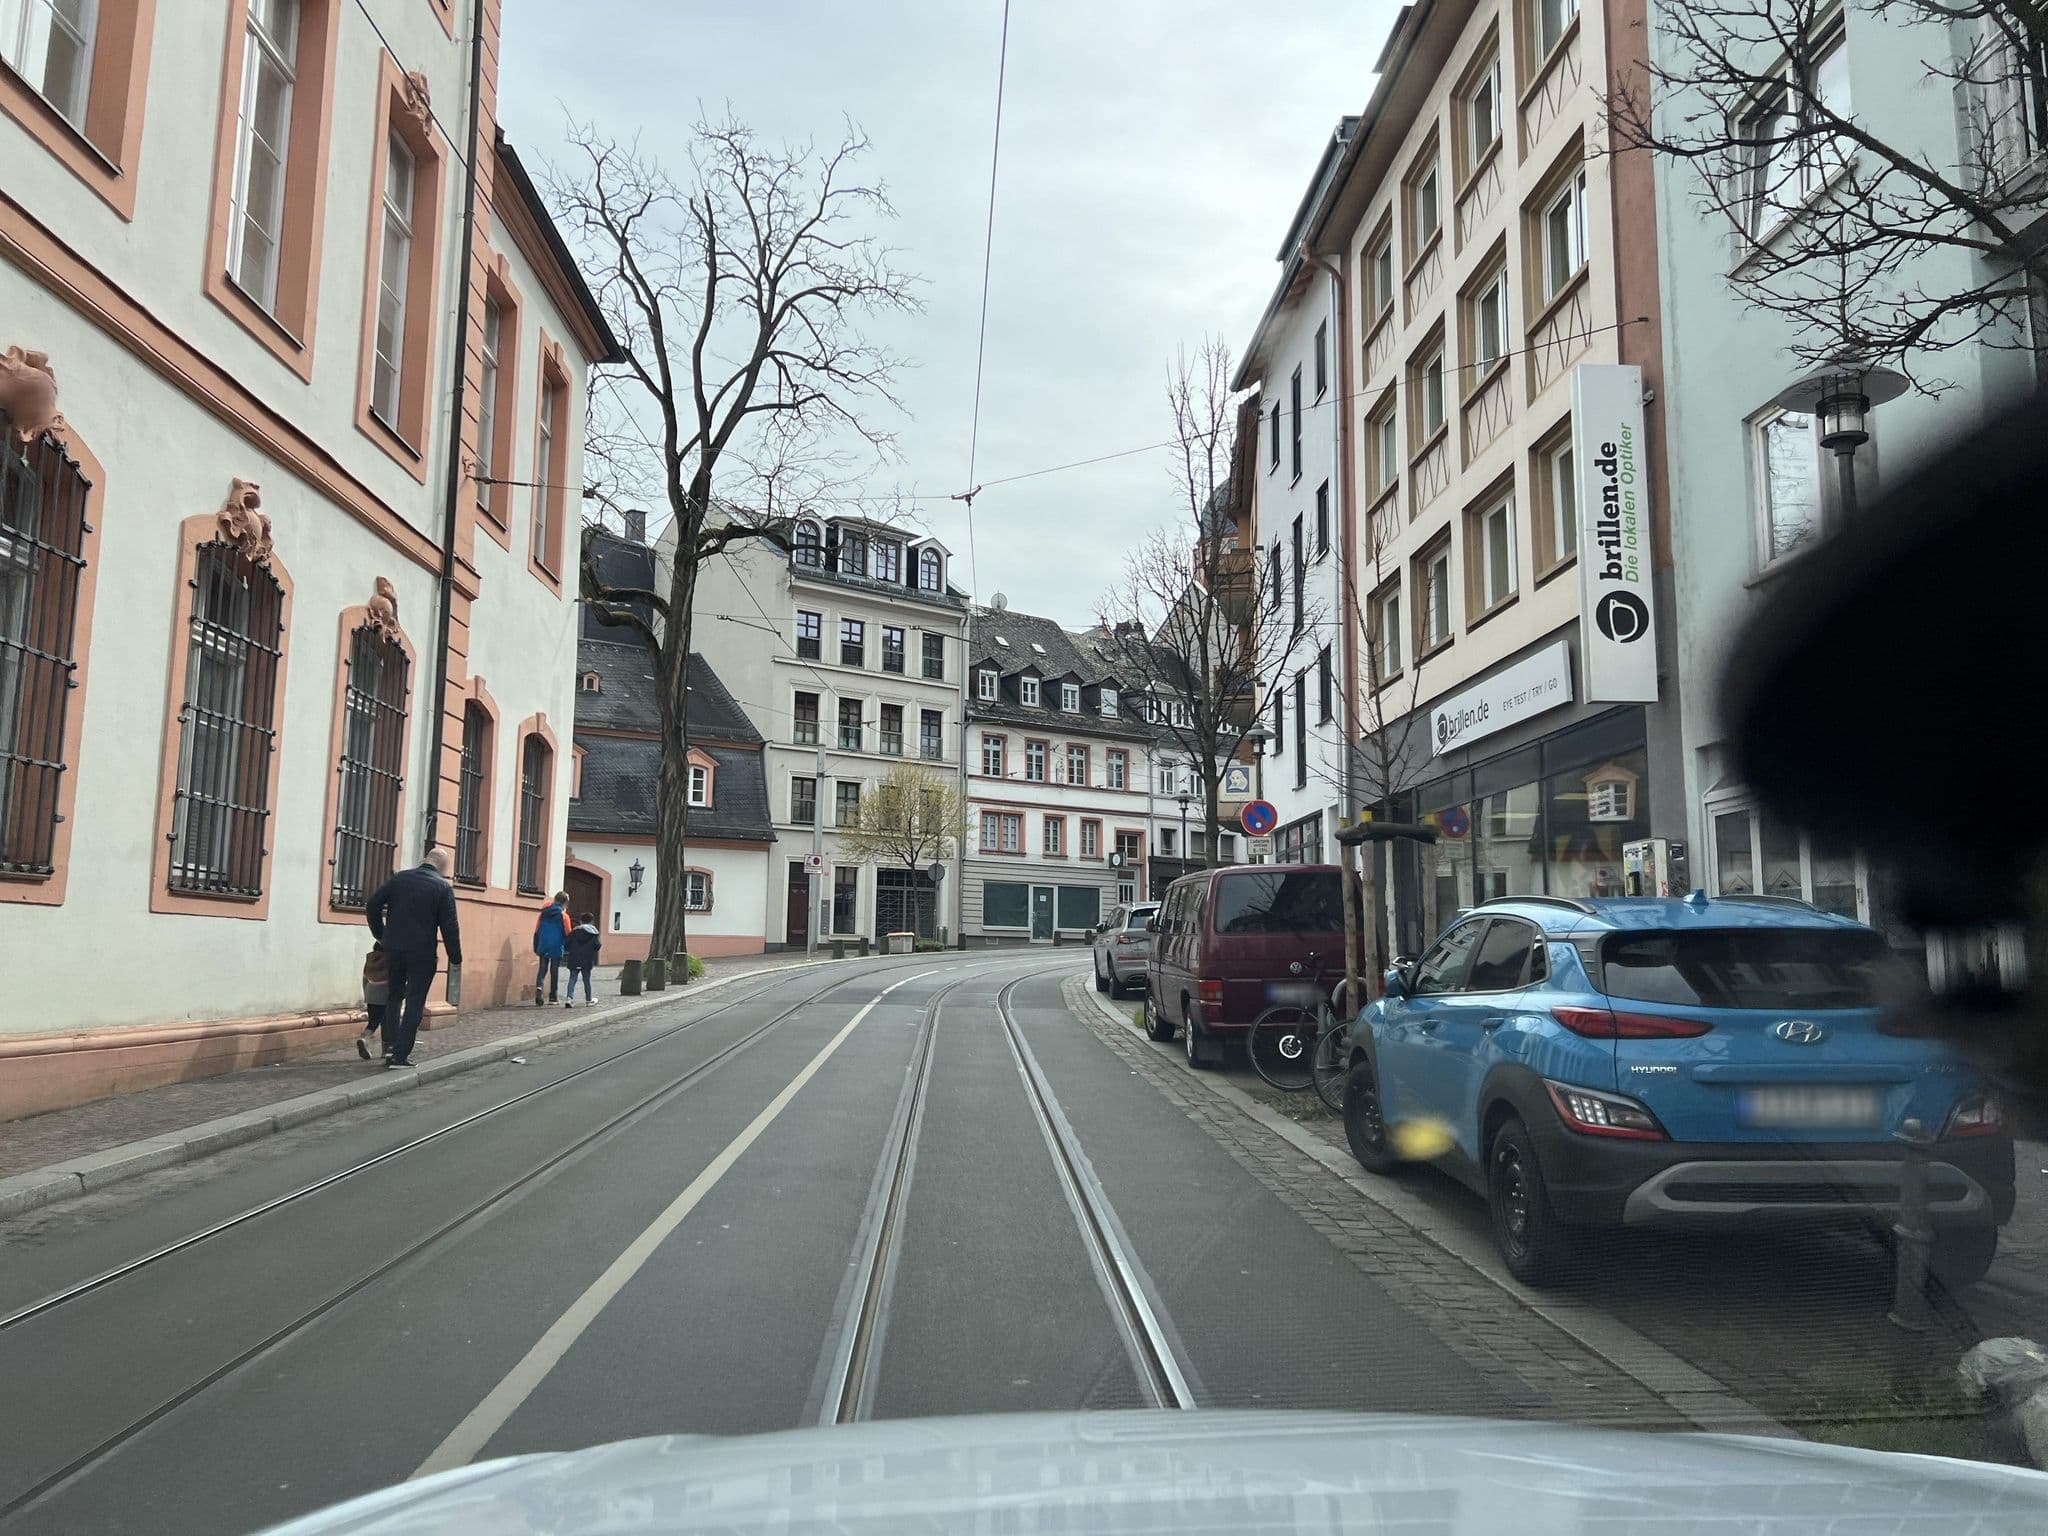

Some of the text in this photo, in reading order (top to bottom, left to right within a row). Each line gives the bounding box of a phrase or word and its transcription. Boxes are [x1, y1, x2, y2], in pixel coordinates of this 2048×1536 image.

[1594, 442, 1623, 580] brillen.de
[1620, 423, 1639, 583] Die lokalen Optiker
[1503, 698, 1513, 711] EYE
[1514, 691, 1527, 706] TEST
[1532, 684, 1543, 698] TRY
[1548, 678, 1558, 690] GO
[1448, 699, 1489, 735] brillen.de
[1631, 1066, 1677, 1074] HYUNDAI
